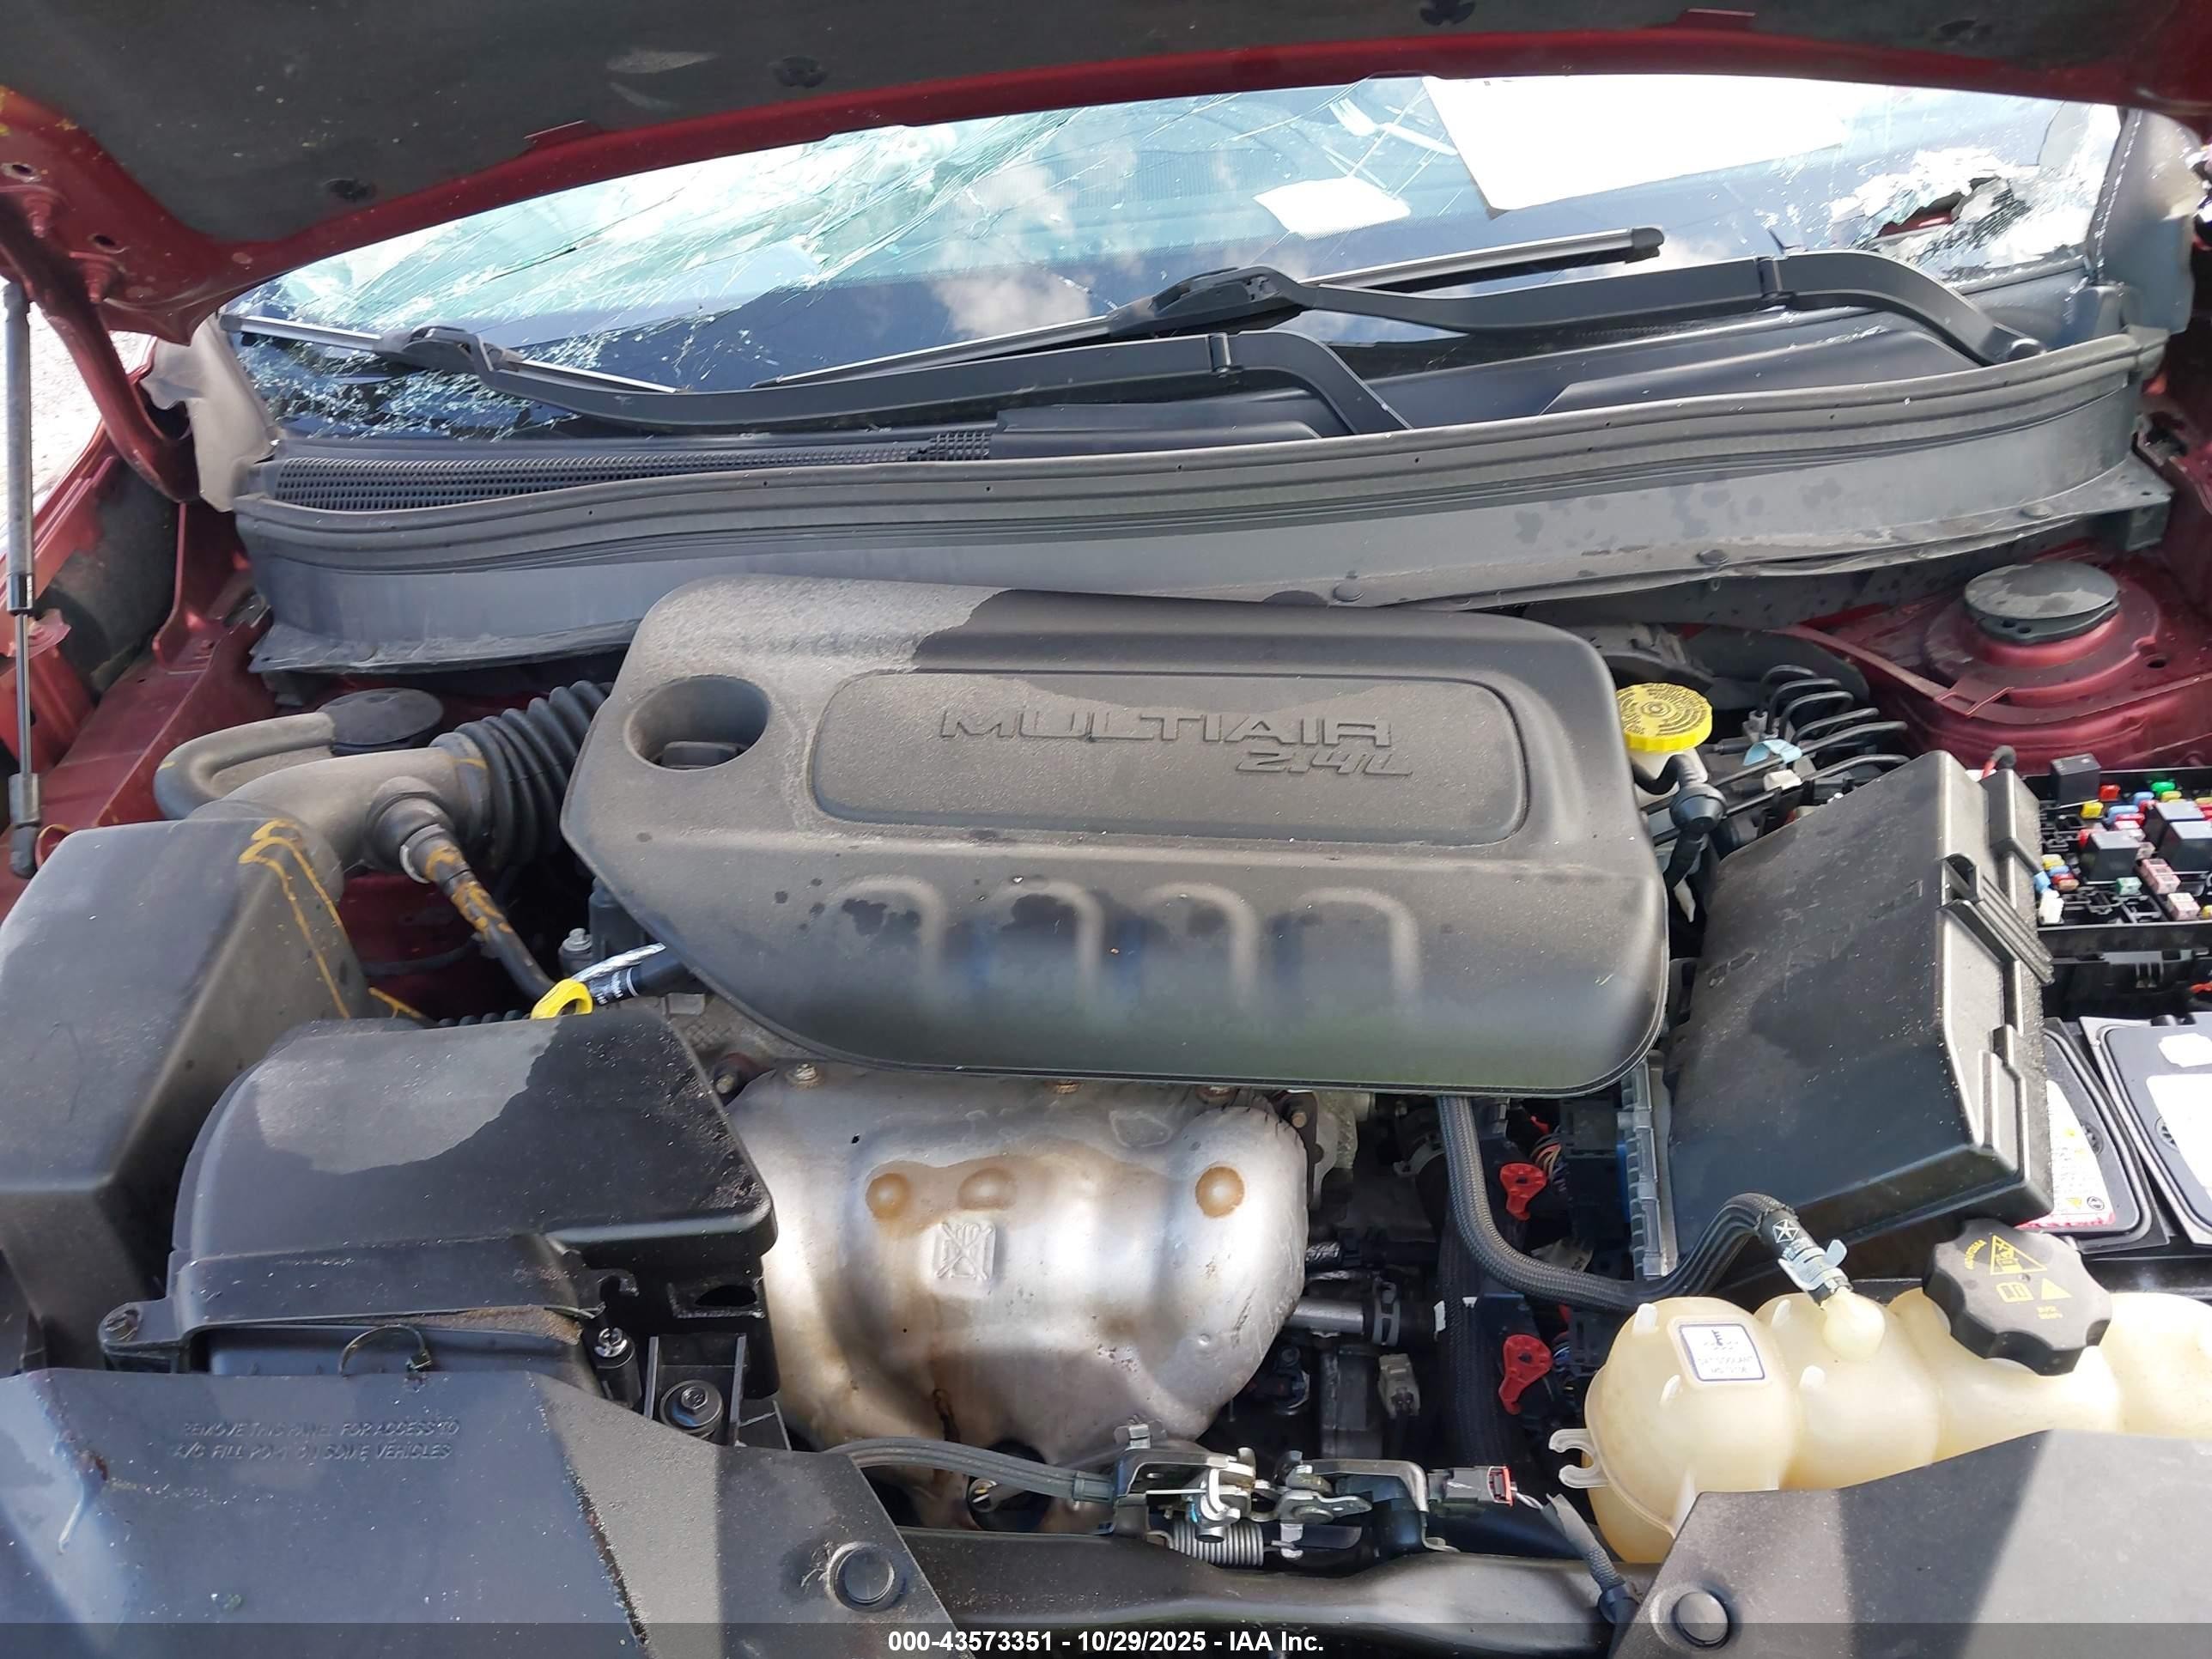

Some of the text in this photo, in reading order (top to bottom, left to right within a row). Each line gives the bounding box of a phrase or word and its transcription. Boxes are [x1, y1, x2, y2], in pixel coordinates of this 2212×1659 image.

[939, 709, 1394, 748] MULTIAIR
[1235, 749, 1413, 776] 2.4L
[184, 1422, 246, 1437] REMOVE
[340, 1422, 373, 1437] FOR
[373, 1420, 436, 1437] ACCESS
[211, 1444, 244, 1459] FILL
[323, 1443, 372, 1460] SOME
[377, 1443, 453, 1460] VEHICLES
